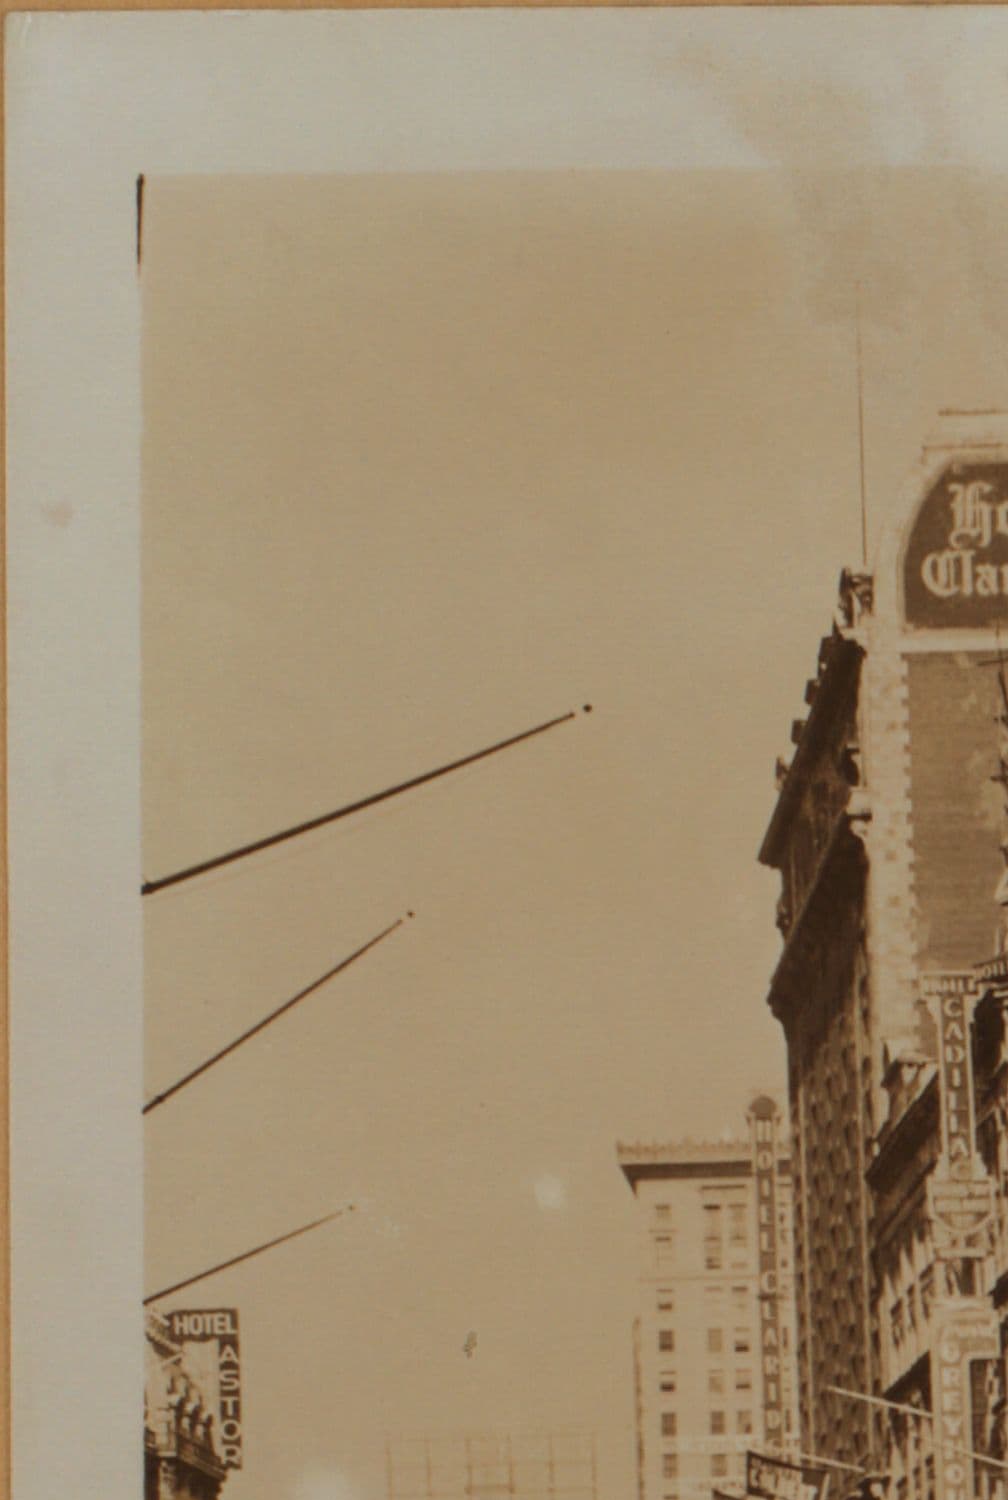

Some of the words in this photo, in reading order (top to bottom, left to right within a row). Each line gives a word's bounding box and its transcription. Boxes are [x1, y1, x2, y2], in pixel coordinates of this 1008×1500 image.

[943, 998, 974, 1176] CADILLAC
[174, 1313, 237, 1335] HOTEL
[219, 1345, 242, 1466] ASTOR
